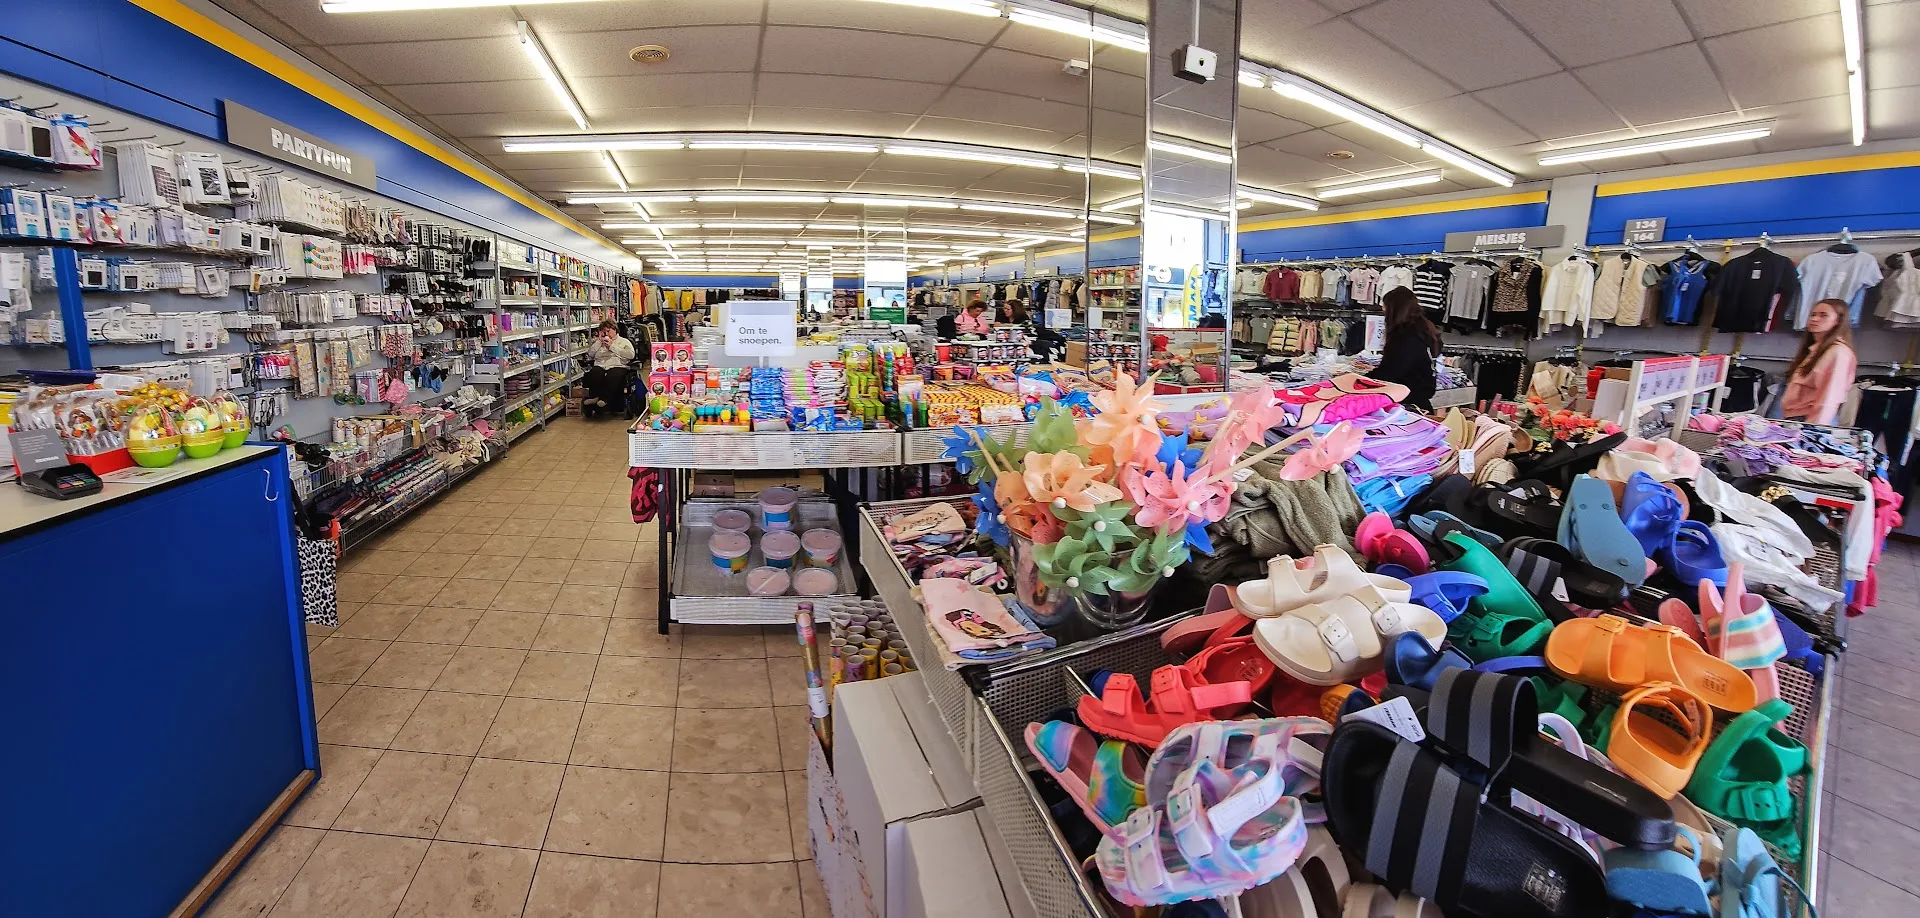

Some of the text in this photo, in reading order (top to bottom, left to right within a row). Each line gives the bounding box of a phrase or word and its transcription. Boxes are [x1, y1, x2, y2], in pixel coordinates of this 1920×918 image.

[270, 127, 352, 175] PARTYFUN
[1635, 220, 1658, 230] 134
[1475, 232, 1527, 246] MEISJES
[1633, 232, 1656, 241] 164
[738, 326, 768, 335] Om te
[738, 338, 782, 346] snoepen.
